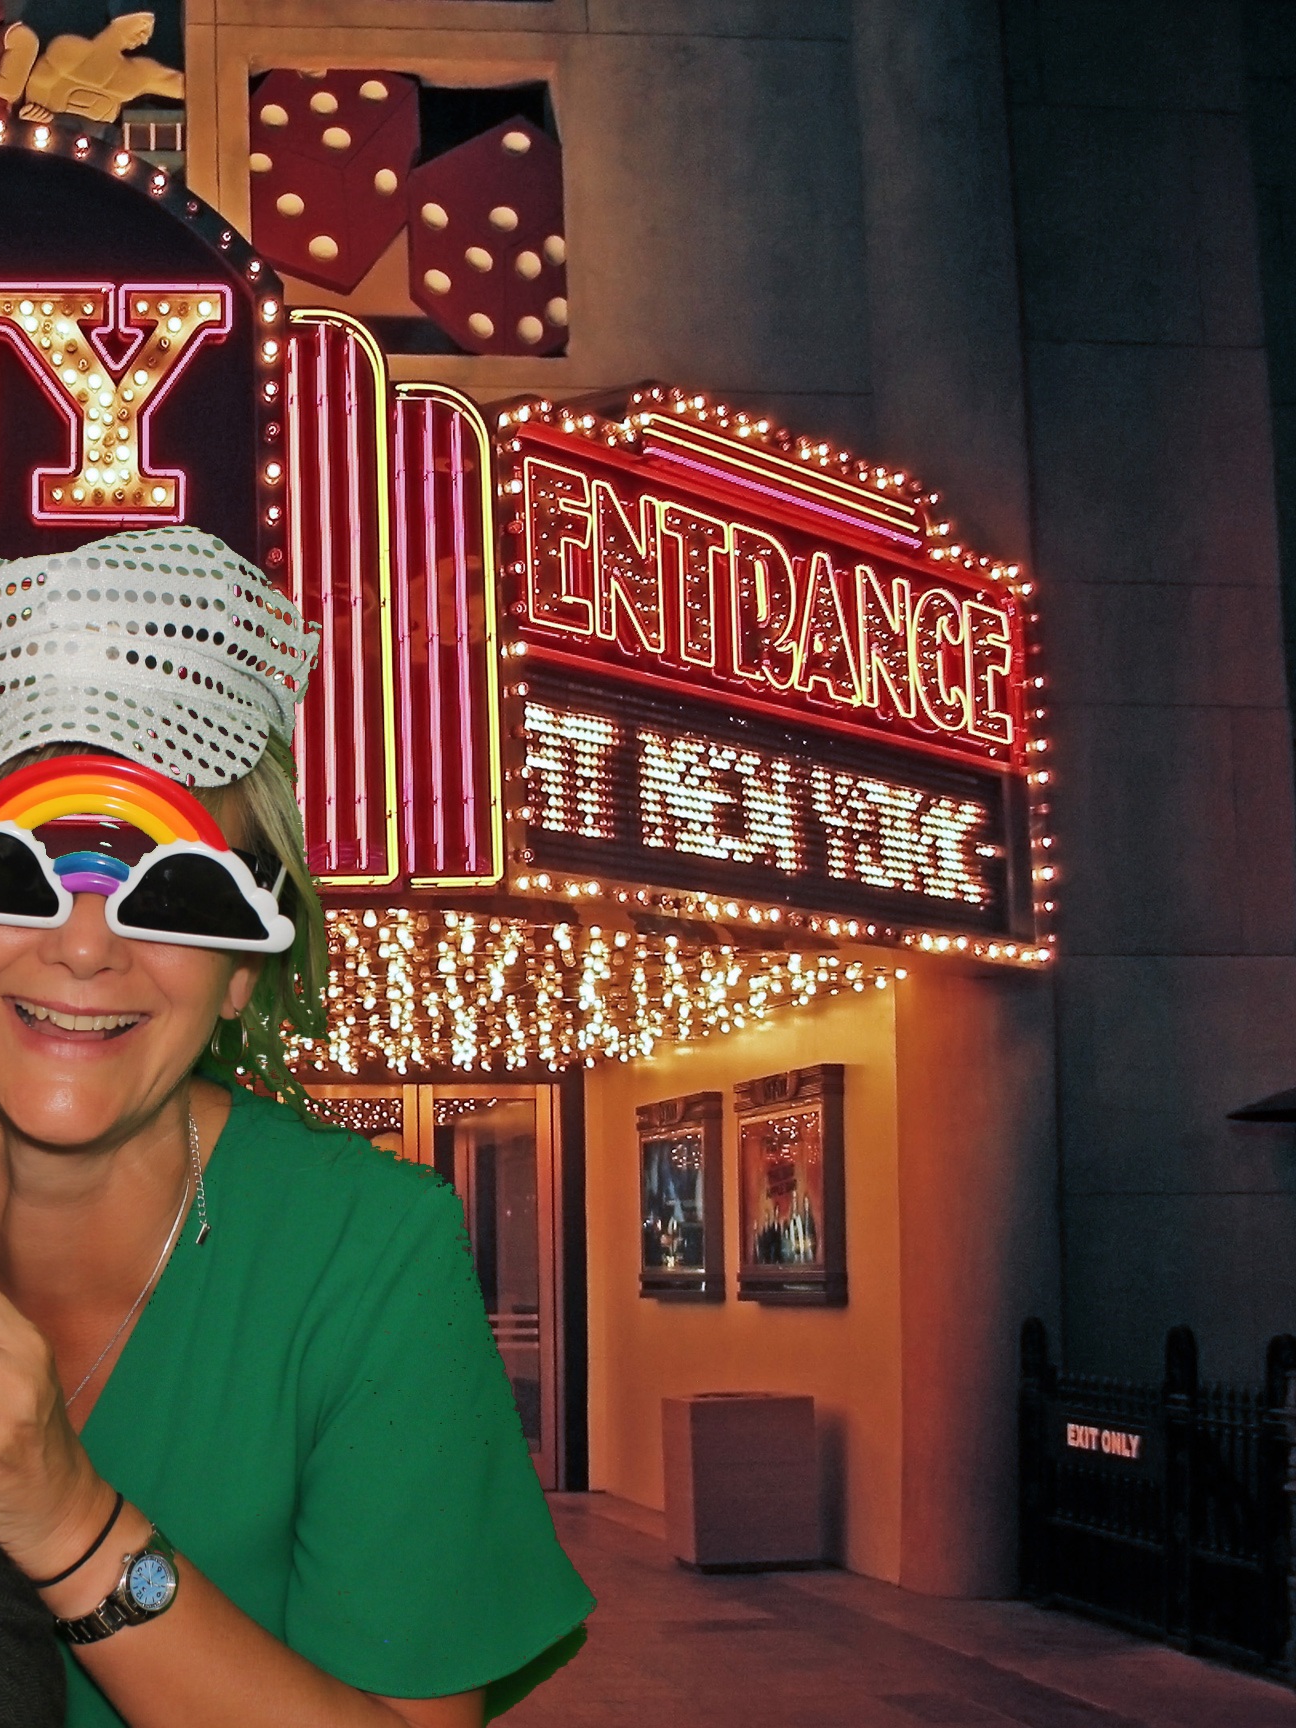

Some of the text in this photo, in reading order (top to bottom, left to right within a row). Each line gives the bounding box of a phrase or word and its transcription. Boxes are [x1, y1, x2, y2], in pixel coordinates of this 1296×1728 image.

[524, 457, 1013, 744] ENTRANCE
[1066, 1422, 1141, 1459] EXIT ONLY
